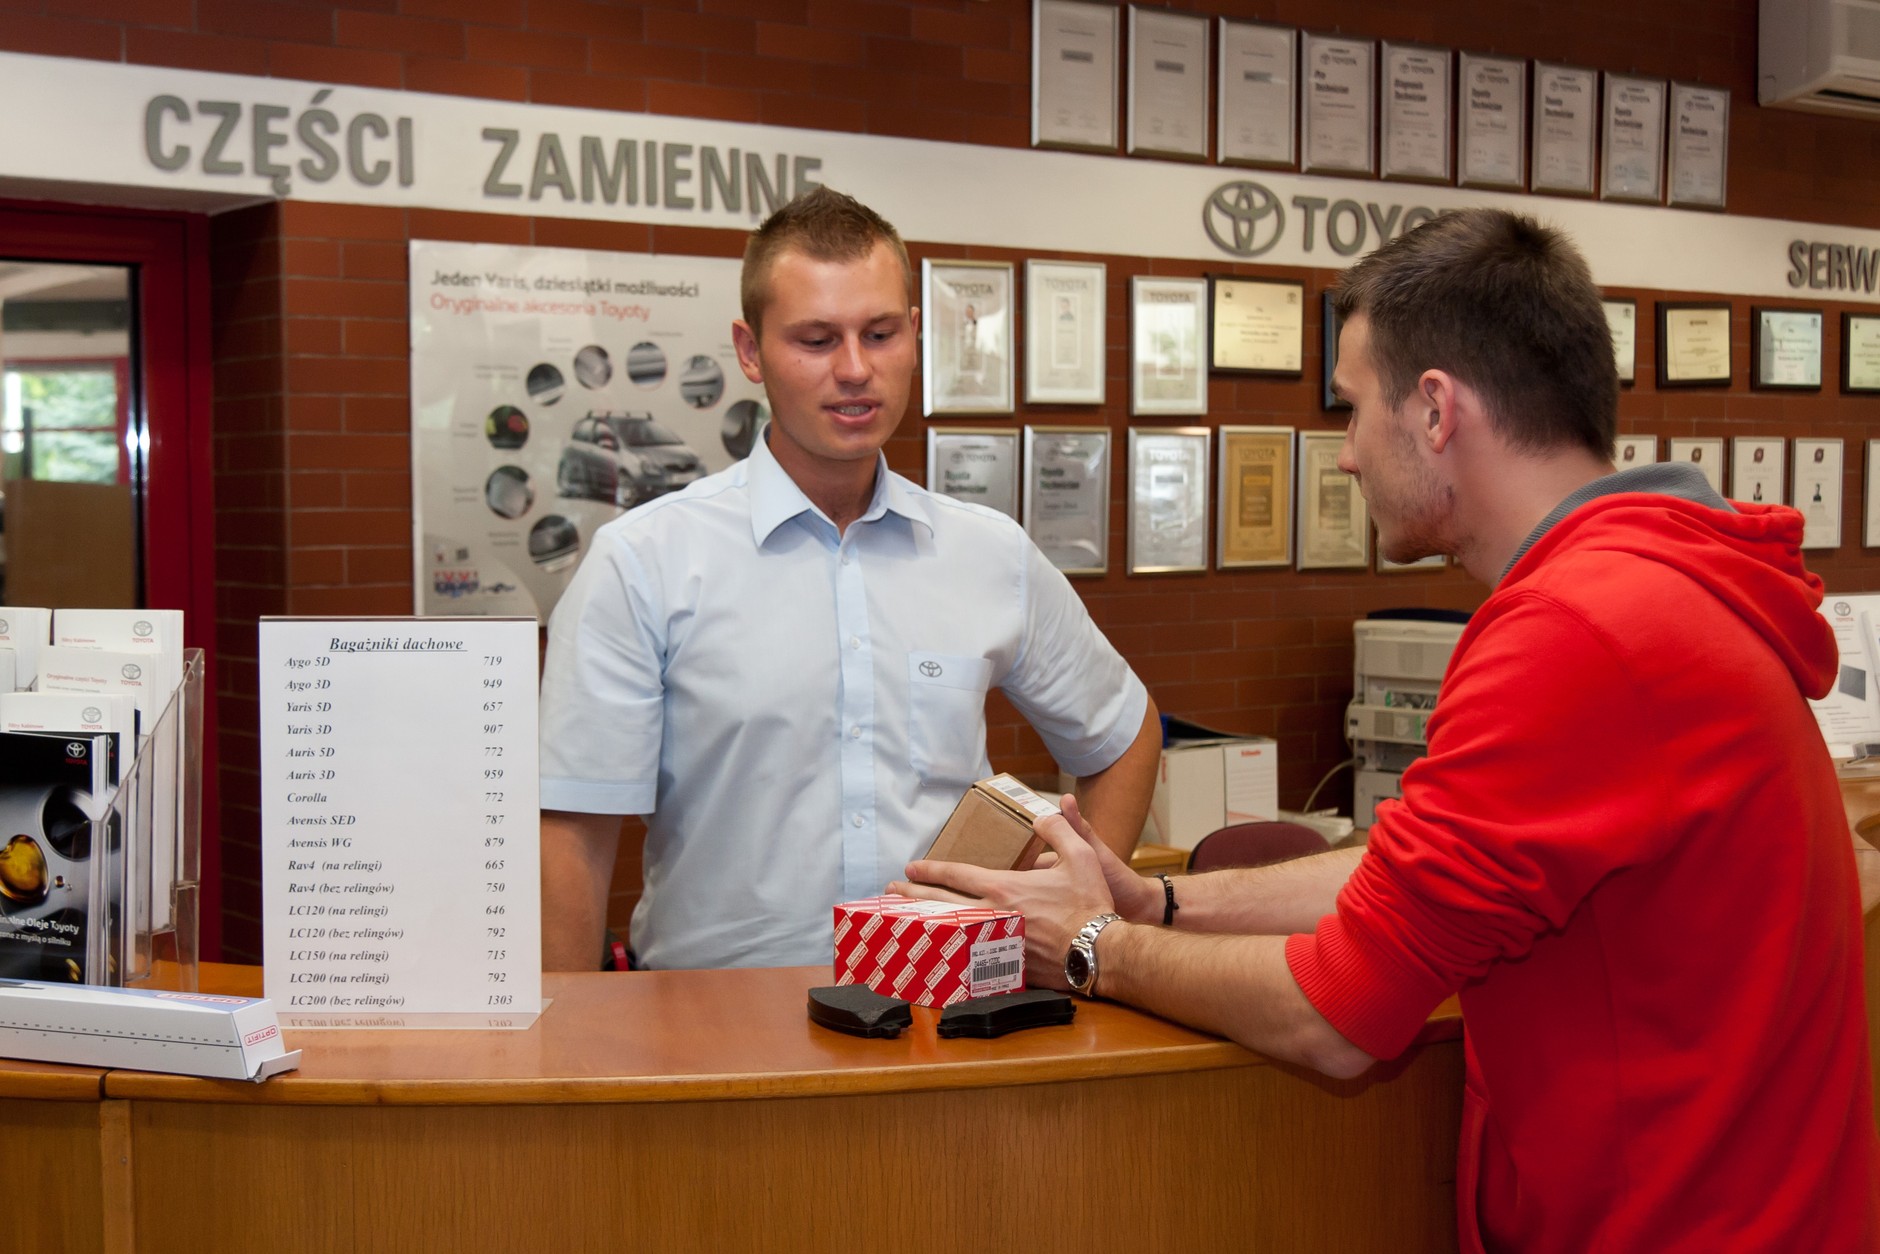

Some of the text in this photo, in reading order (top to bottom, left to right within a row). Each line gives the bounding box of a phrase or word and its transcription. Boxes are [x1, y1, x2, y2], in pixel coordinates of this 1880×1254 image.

[145, 88, 416, 197] CZĘŚCI
[1787, 239, 1880, 295] SERW
[430, 269, 481, 287] Jeden
[329, 637, 463, 653] Bagażniki dachowe
[285, 656, 503, 669] Aygo 5D 719
[120, 679, 142, 687] TOYOTA
[285, 679, 503, 692] Aygo 3D 949
[286, 701, 503, 712] Yaris 5D 657
[286, 724, 504, 735] Yaris 3D 907
[286, 746, 504, 758] Auris 5D 772
[286, 769, 504, 780] Auris 3D 959
[287, 792, 504, 803] Corolla 772
[287, 814, 505, 826] Avensis SED 787
[287, 837, 505, 848] Avensis WG 879
[287, 859, 505, 873] Rav4 (na relingi) 665
[287, 882, 506, 895] Rav4 (bez relingów) 750
[288, 905, 505, 918] LC120 (na relingi) 646
[26, 916, 50, 931] Oleje
[50, 920, 80, 936] Toyoty
[288, 927, 506, 940] LC120 (bez relingów) 792
[289, 949, 506, 963] LC150 (na relingi) 715
[289, 972, 507, 985] LC200 (na relingi) 792
[290, 994, 513, 1007] LC200 (bez relingów) 1303
